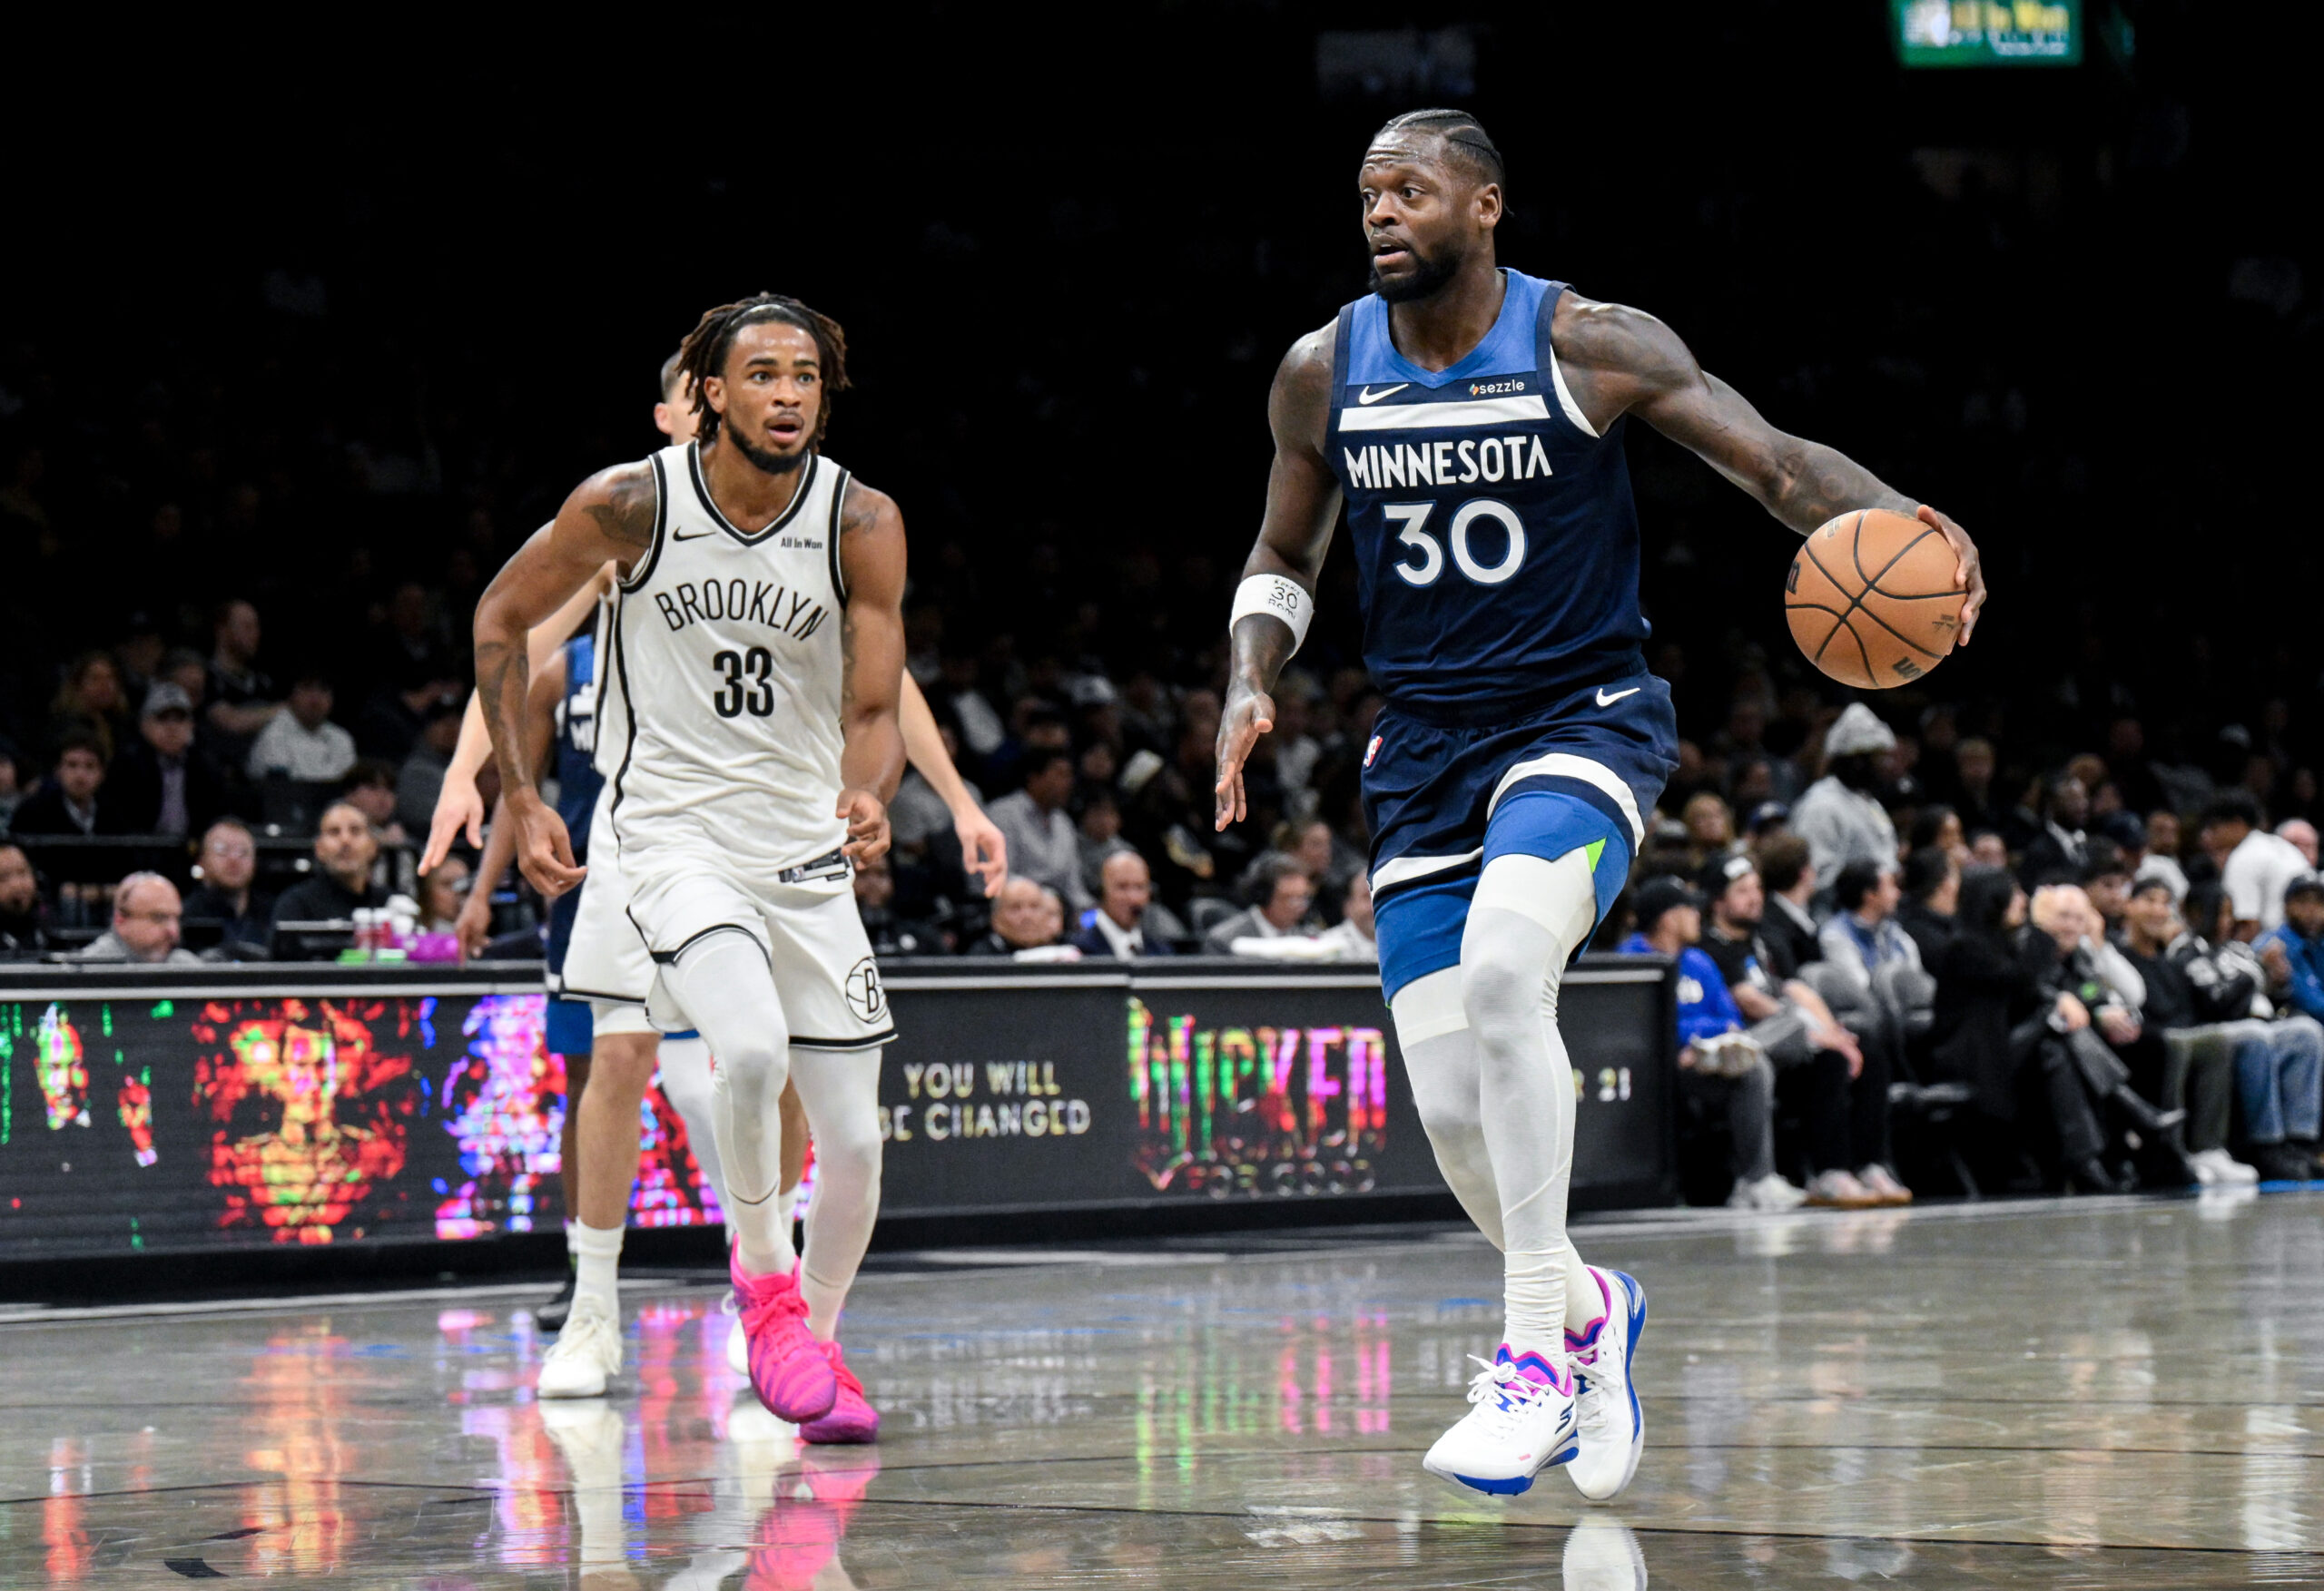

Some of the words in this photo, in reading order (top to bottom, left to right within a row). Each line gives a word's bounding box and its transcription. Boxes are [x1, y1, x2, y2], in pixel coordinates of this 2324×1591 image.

[1479, 379, 1525, 394] sezzle
[1344, 434, 1553, 488] MINNESOTA
[781, 536, 793, 547] All
[794, 537, 803, 547] In
[804, 537, 822, 549] Won
[1383, 497, 1528, 587] 30
[655, 578, 829, 641] BROOKLYN
[1271, 586, 1297, 609] 30
[713, 646, 774, 718] 33
[864, 967, 880, 1014] B
[903, 1062, 974, 1099] YOU
[985, 1059, 1062, 1096] WILL
[924, 1099, 1091, 1141] CHANGED
